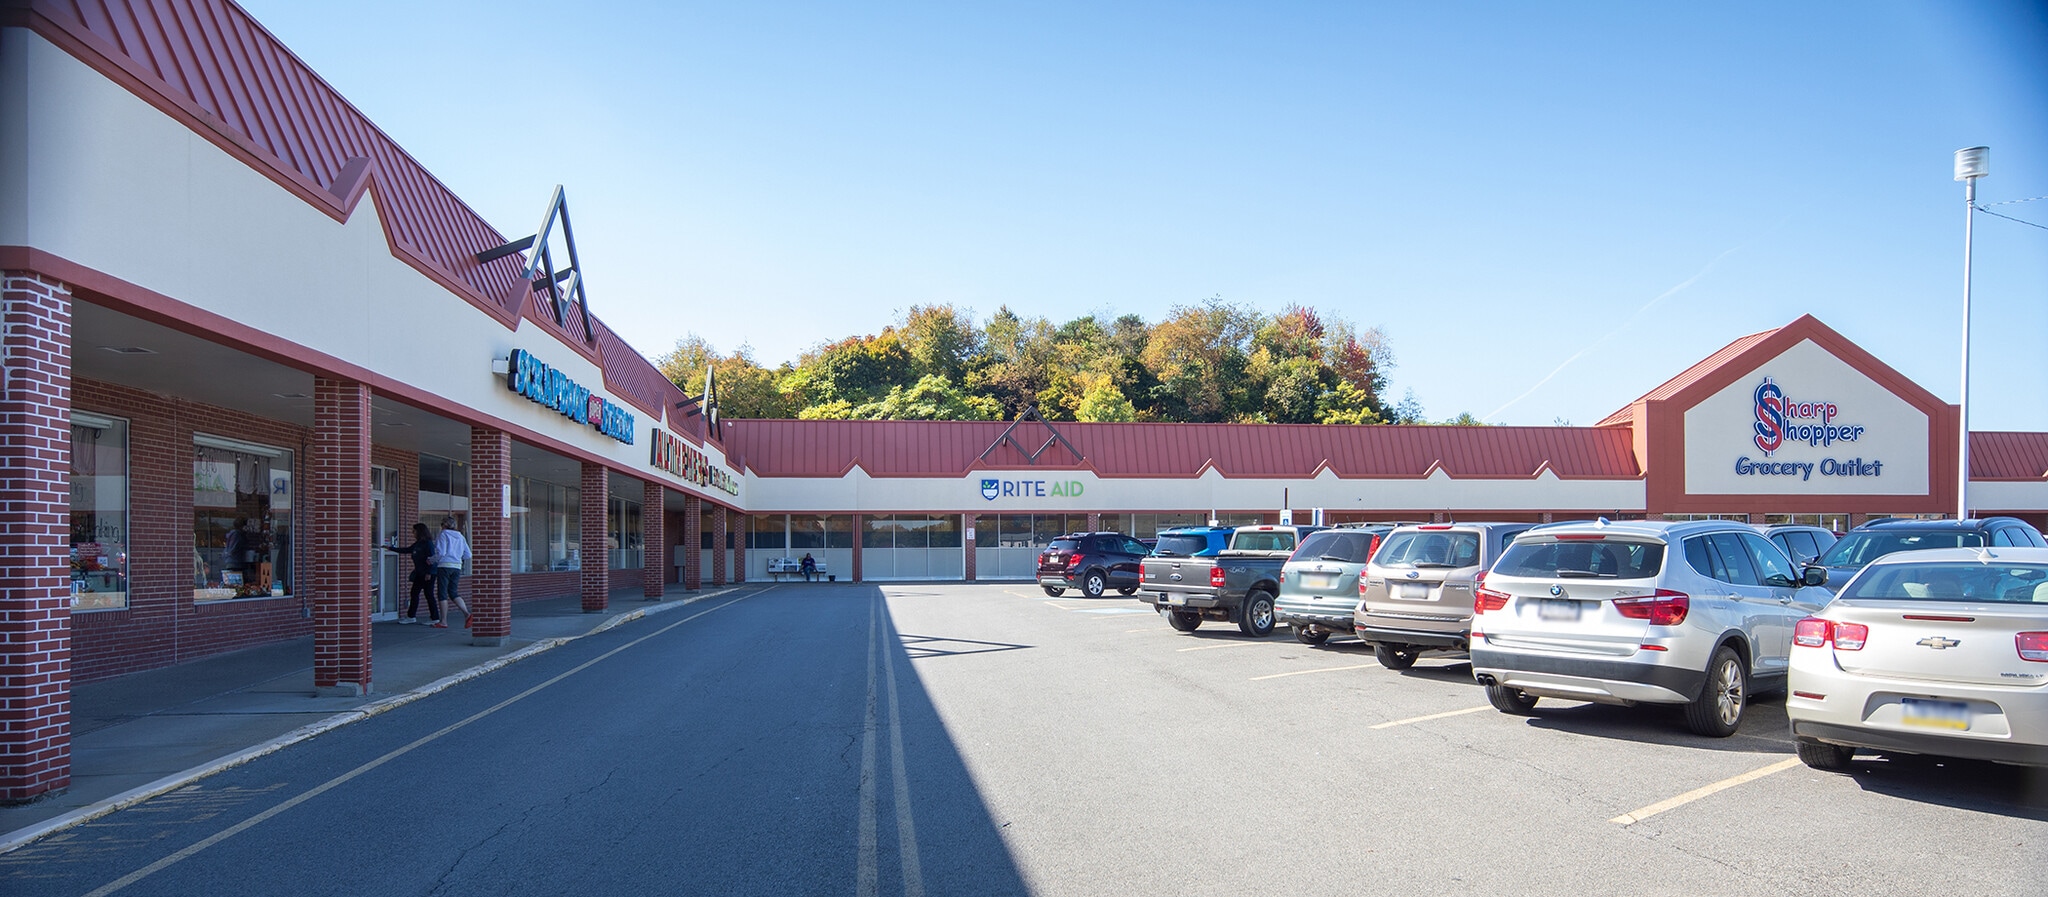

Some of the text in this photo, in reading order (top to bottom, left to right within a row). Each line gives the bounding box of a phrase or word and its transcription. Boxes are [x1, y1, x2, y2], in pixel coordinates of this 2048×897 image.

[1755, 377, 1838, 424] Sharp
[1755, 419, 1865, 456] Shopper
[1735, 456, 1883, 481] Grocery Outlet
[1003, 481, 1085, 497] RITE AID
